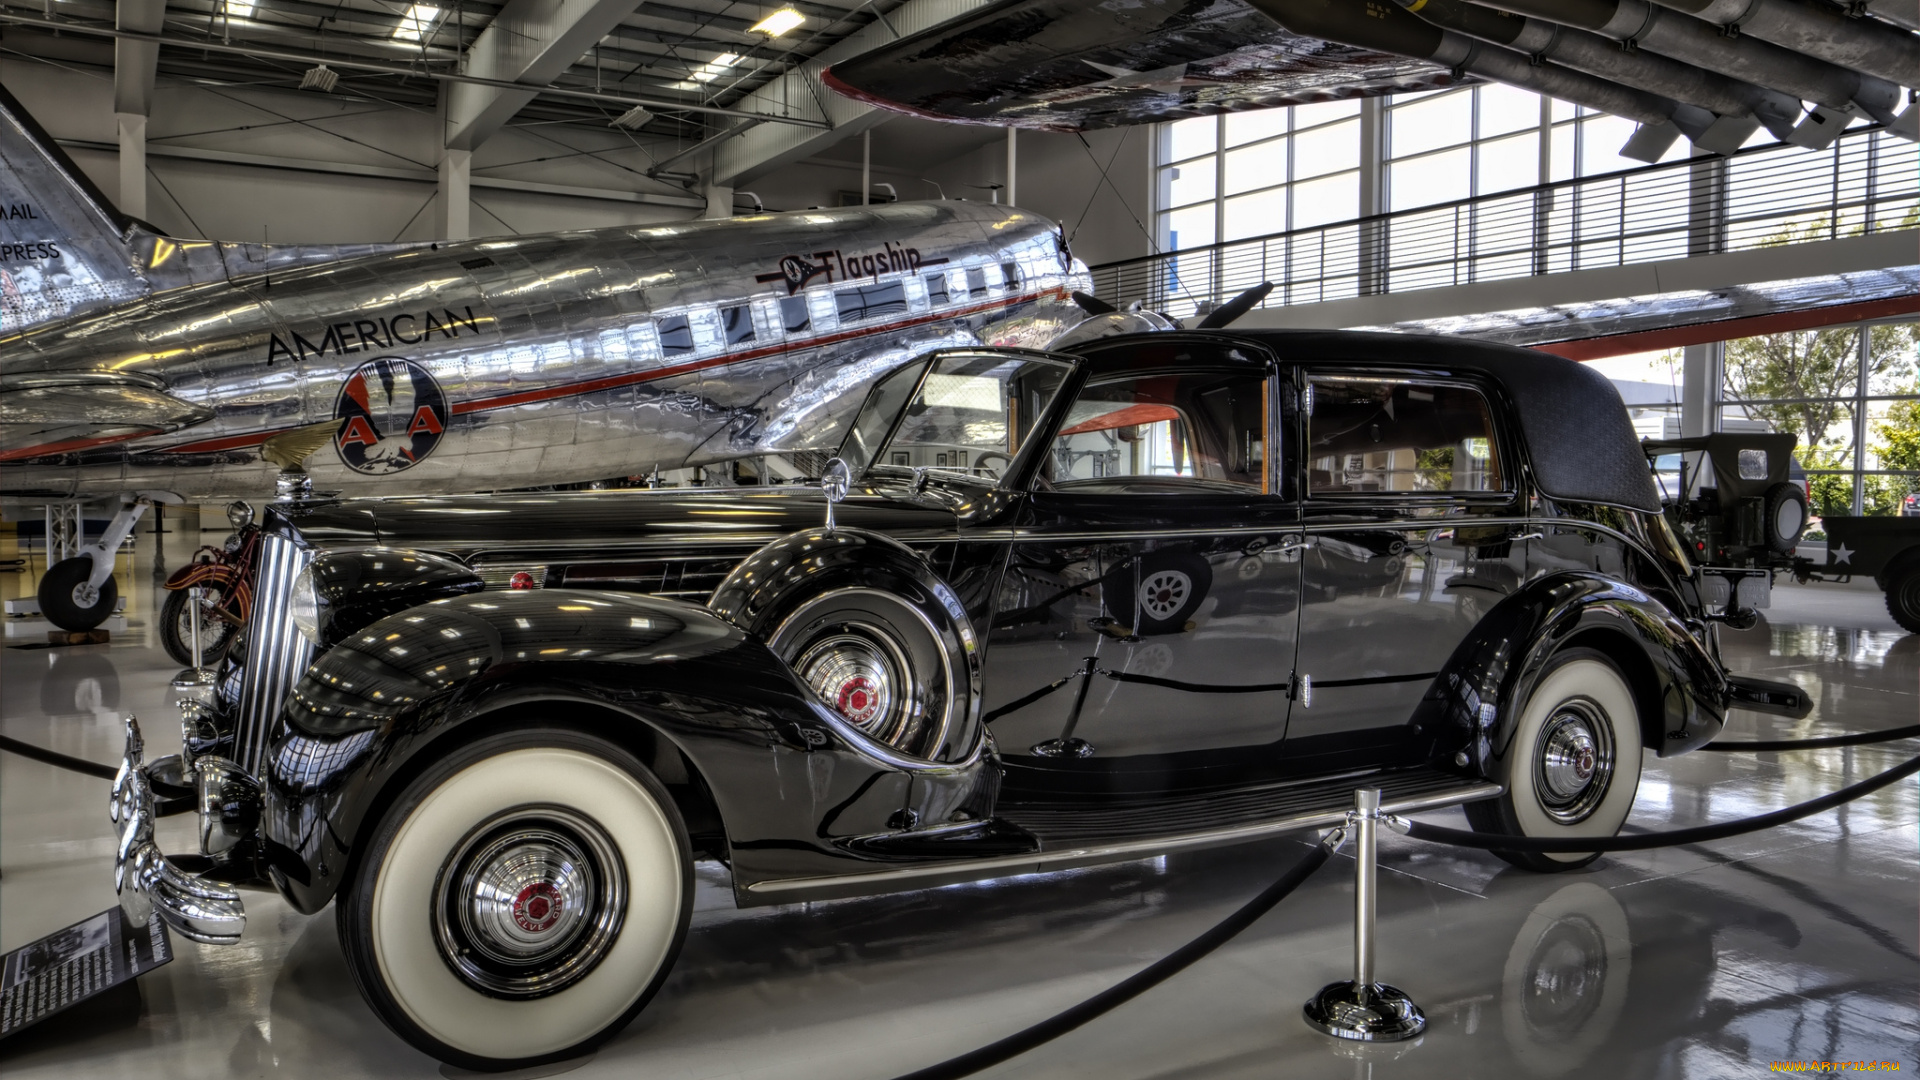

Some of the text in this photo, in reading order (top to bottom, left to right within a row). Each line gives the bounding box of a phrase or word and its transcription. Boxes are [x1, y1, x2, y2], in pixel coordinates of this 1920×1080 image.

[0, 243, 60, 262] PRESS
[812, 241, 922, 284] Flagship
[267, 305, 480, 366] AMERICAN
[339, 404, 444, 449] A A
[515, 900, 545, 931] TWELVE
